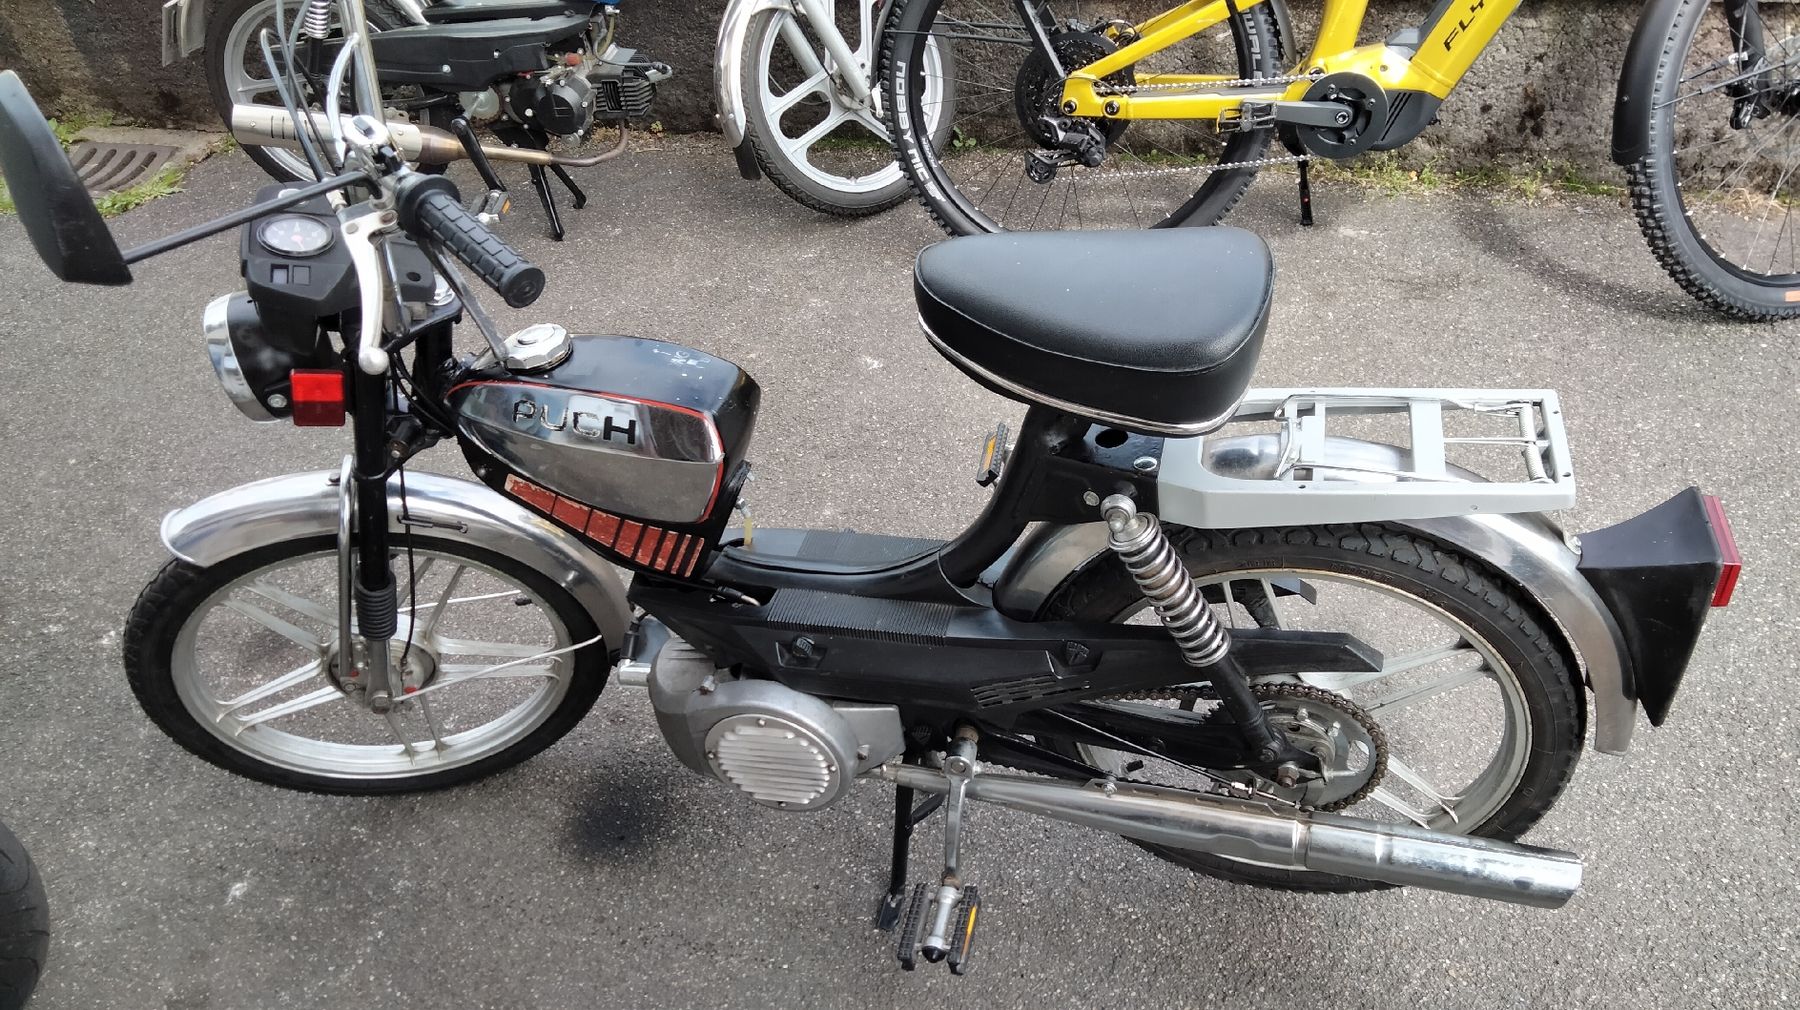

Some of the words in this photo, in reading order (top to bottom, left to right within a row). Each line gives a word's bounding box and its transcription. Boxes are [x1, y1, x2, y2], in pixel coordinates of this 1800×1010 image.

[895, 60, 915, 144] NOBBY
[907, 148, 930, 182] NIC
[512, 399, 637, 445] PUCH
